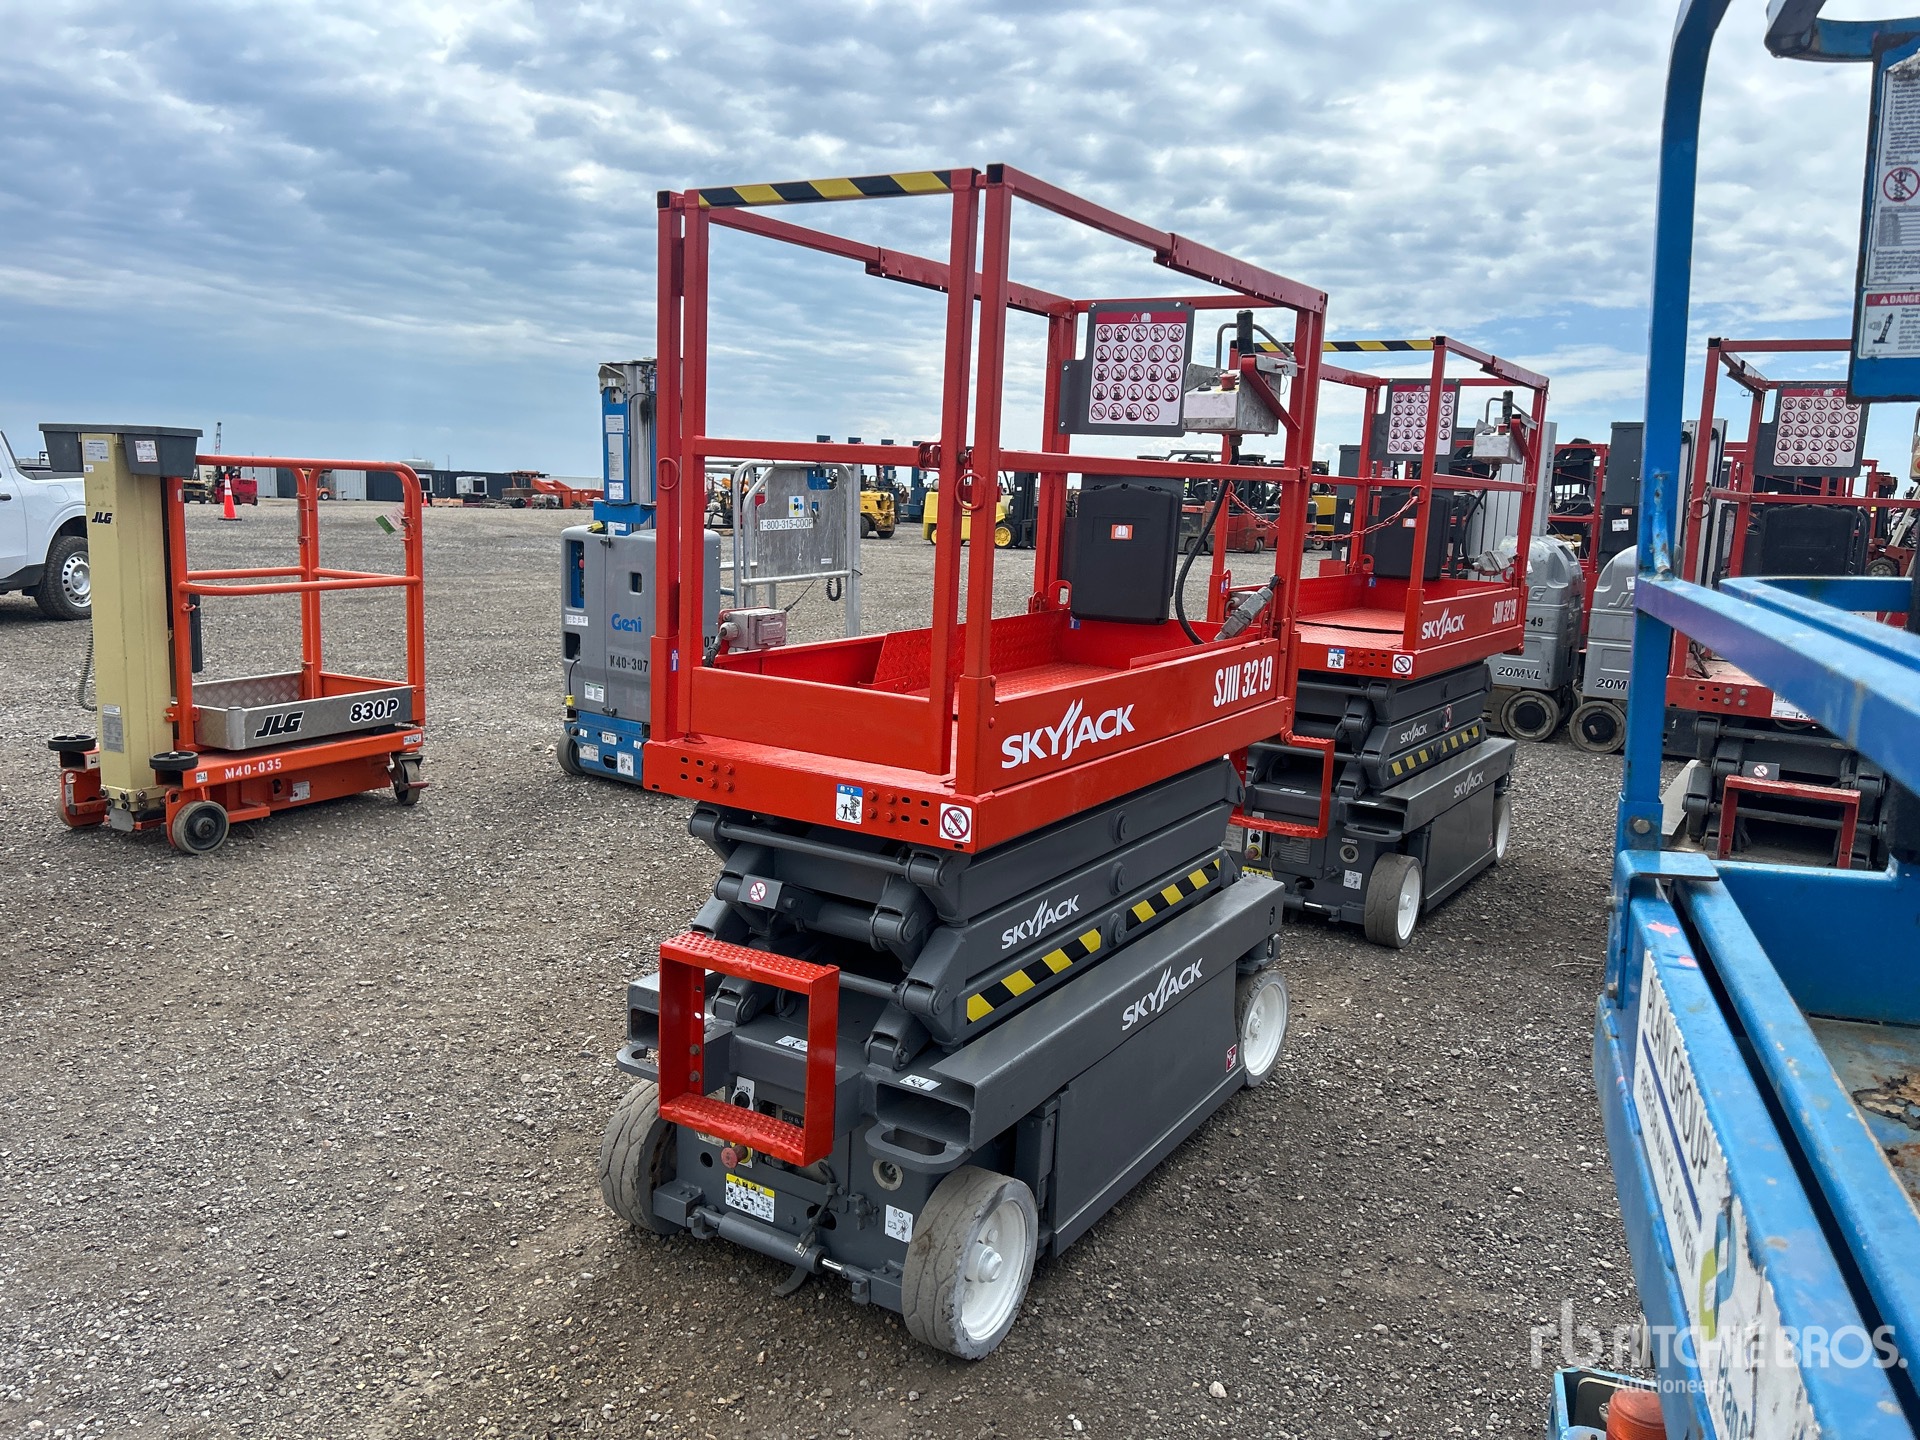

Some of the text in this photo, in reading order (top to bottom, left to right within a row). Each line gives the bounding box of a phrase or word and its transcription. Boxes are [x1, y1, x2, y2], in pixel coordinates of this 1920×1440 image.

[1889, 294, 1920, 304] DANGE
[92, 512, 113, 524] JLG
[760, 518, 813, 530] 1-800-315-COOP
[1607, 592, 1635, 607] JL
[1421, 607, 1465, 640] SKYJACK
[1242, 655, 1273, 699] 3219
[1496, 666, 1542, 680] 20MVL
[1596, 678, 1629, 691] 20M
[350, 698, 399, 723] 830P
[254, 711, 304, 739] JLG
[1001, 697, 1136, 769] SKYJACK
[1400, 722, 1428, 744] SKYJACK
[224, 757, 283, 780] M40-035
[1453, 769, 1484, 798] SKYJACK
[1001, 894, 1080, 950] SKYJACK
[1121, 957, 1203, 1031] SKYJACK
[1669, 1046, 1710, 1185] GROUP
